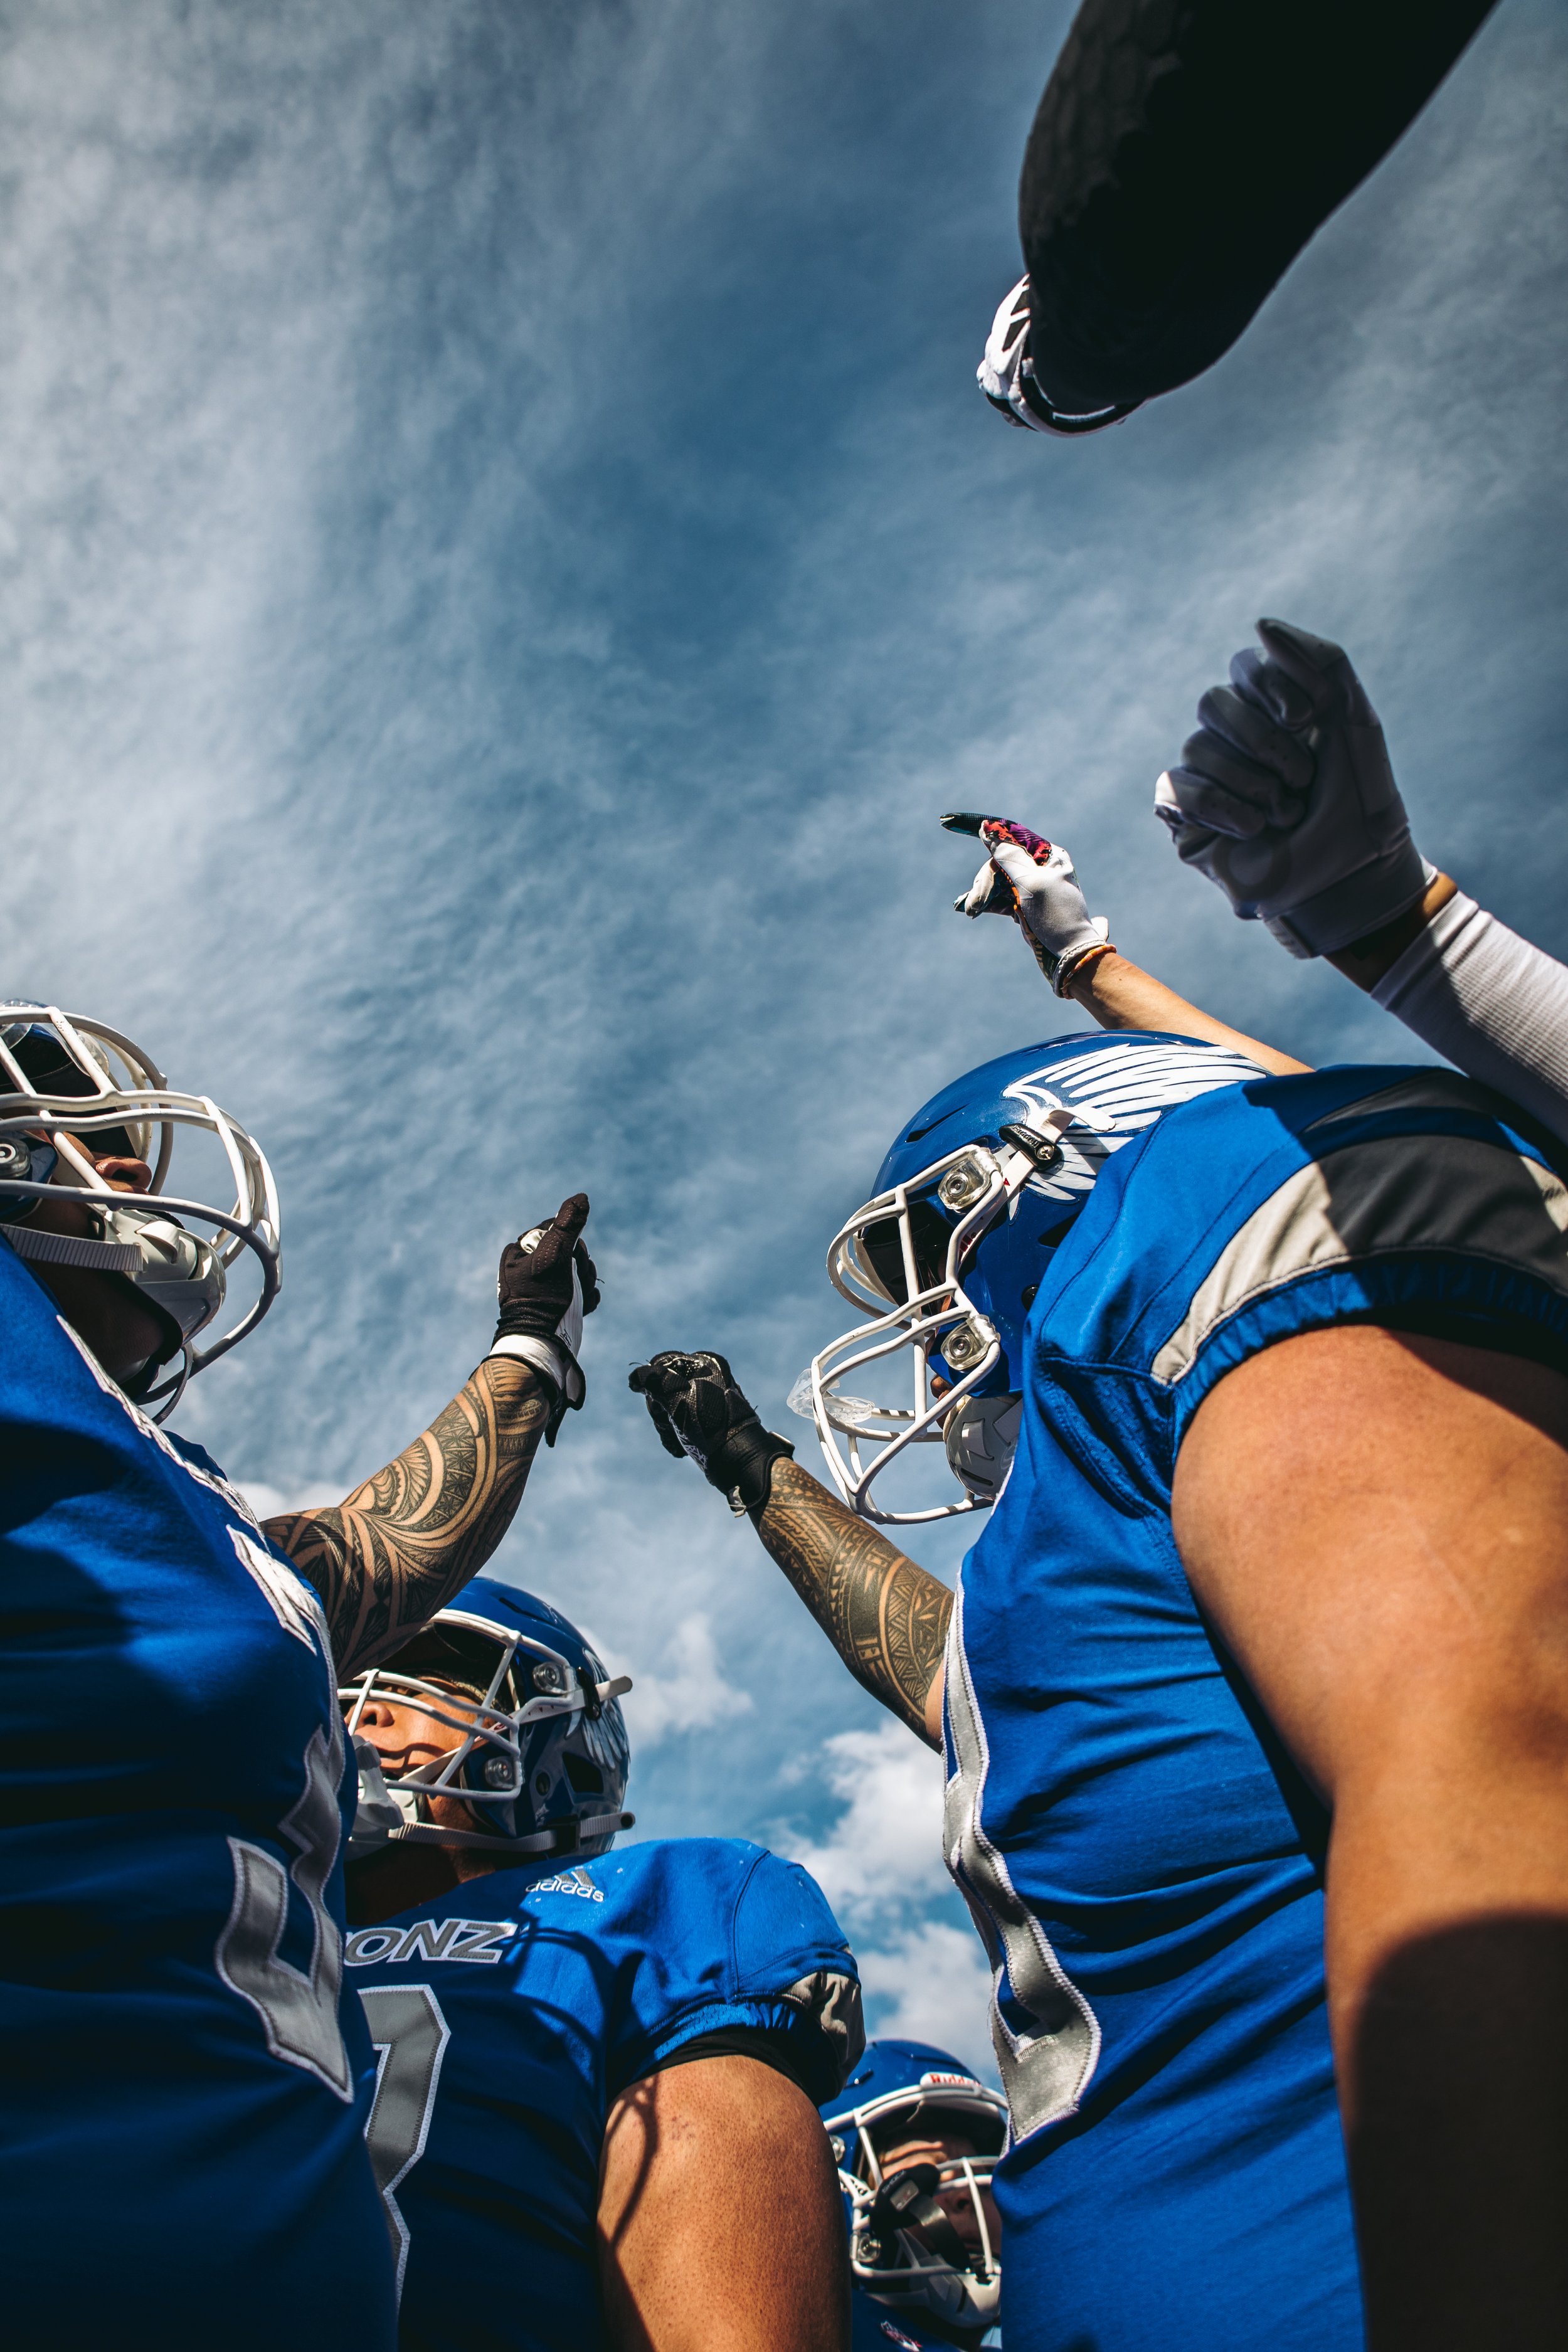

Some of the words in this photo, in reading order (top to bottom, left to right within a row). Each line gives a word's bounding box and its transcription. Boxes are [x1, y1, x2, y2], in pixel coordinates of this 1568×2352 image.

[526, 1880, 604, 1902] adidas
[344, 1918, 519, 1967] ONZ
[930, 2074, 982, 2087] Ridd
